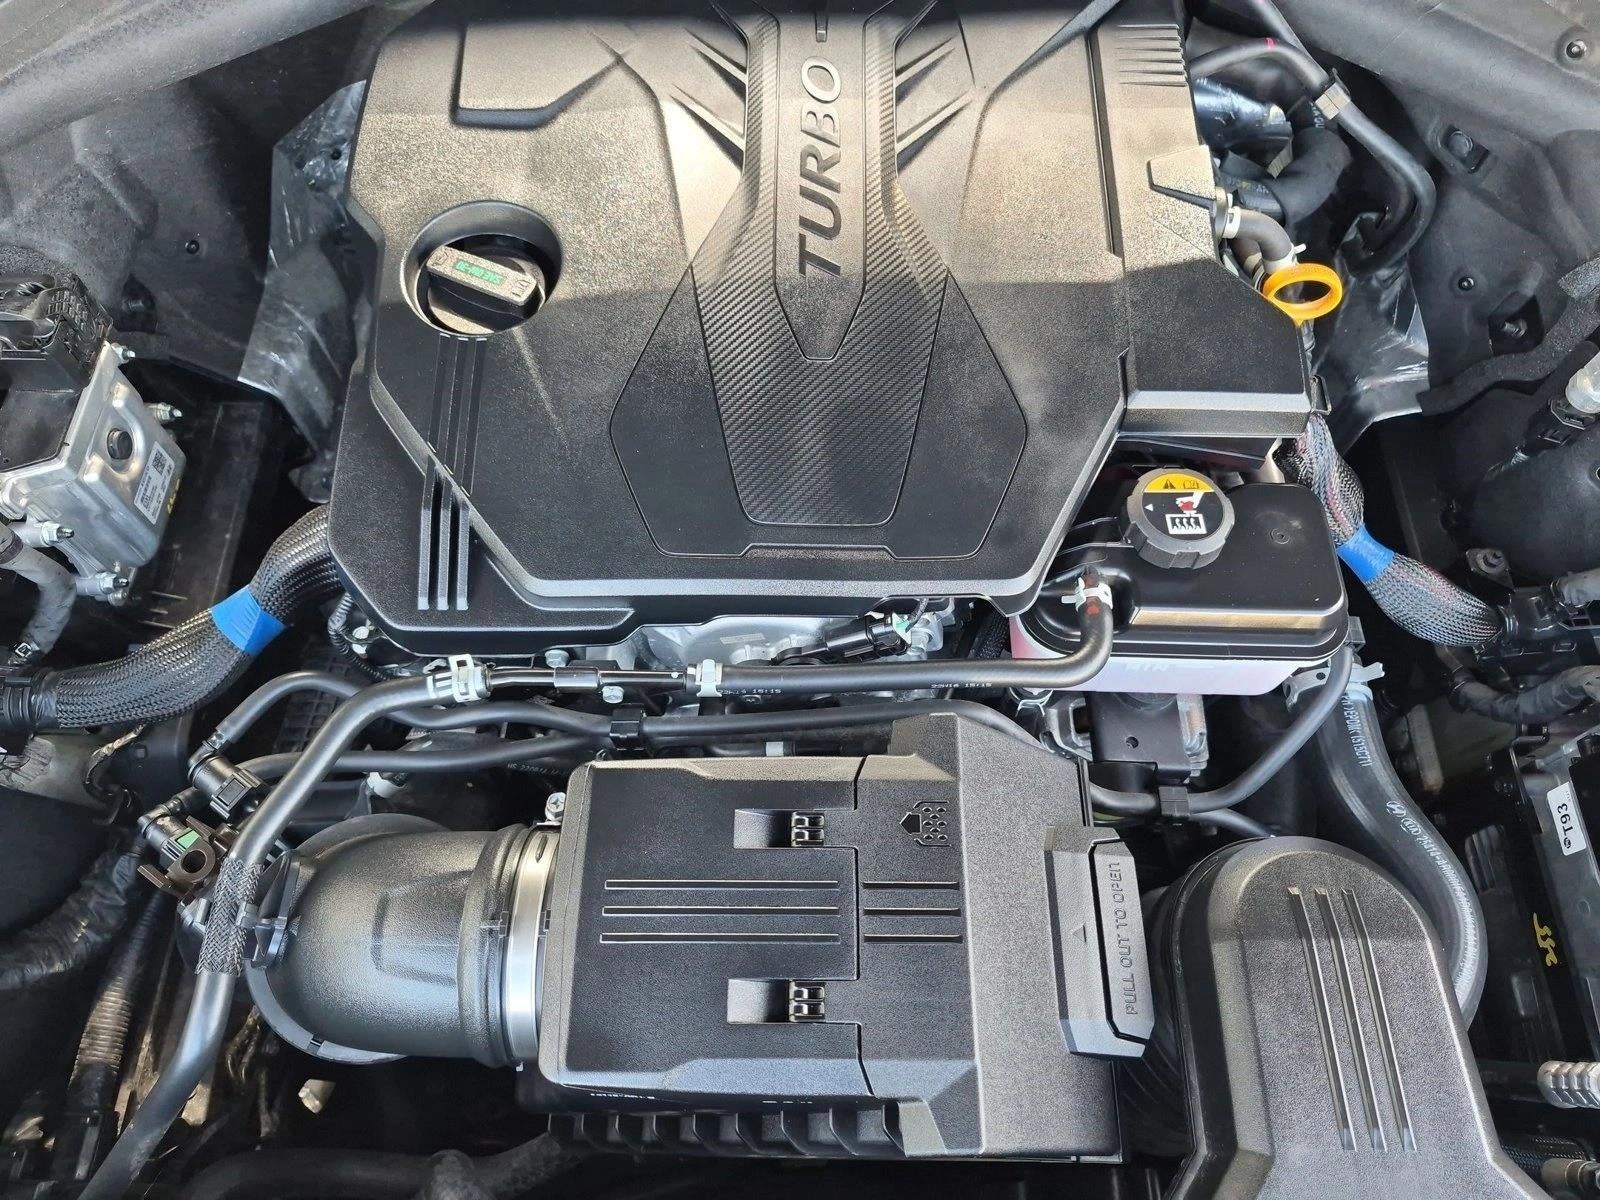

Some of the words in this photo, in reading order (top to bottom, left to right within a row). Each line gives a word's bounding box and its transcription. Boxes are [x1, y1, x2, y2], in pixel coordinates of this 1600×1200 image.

[798, 56, 843, 278] TURBO
[1557, 803, 1573, 836] T93
[1108, 862, 1125, 904] OPEN
[1115, 908, 1128, 930] TO
[1117, 934, 1133, 968] OUT
[1123, 973, 1138, 1014] PULL
